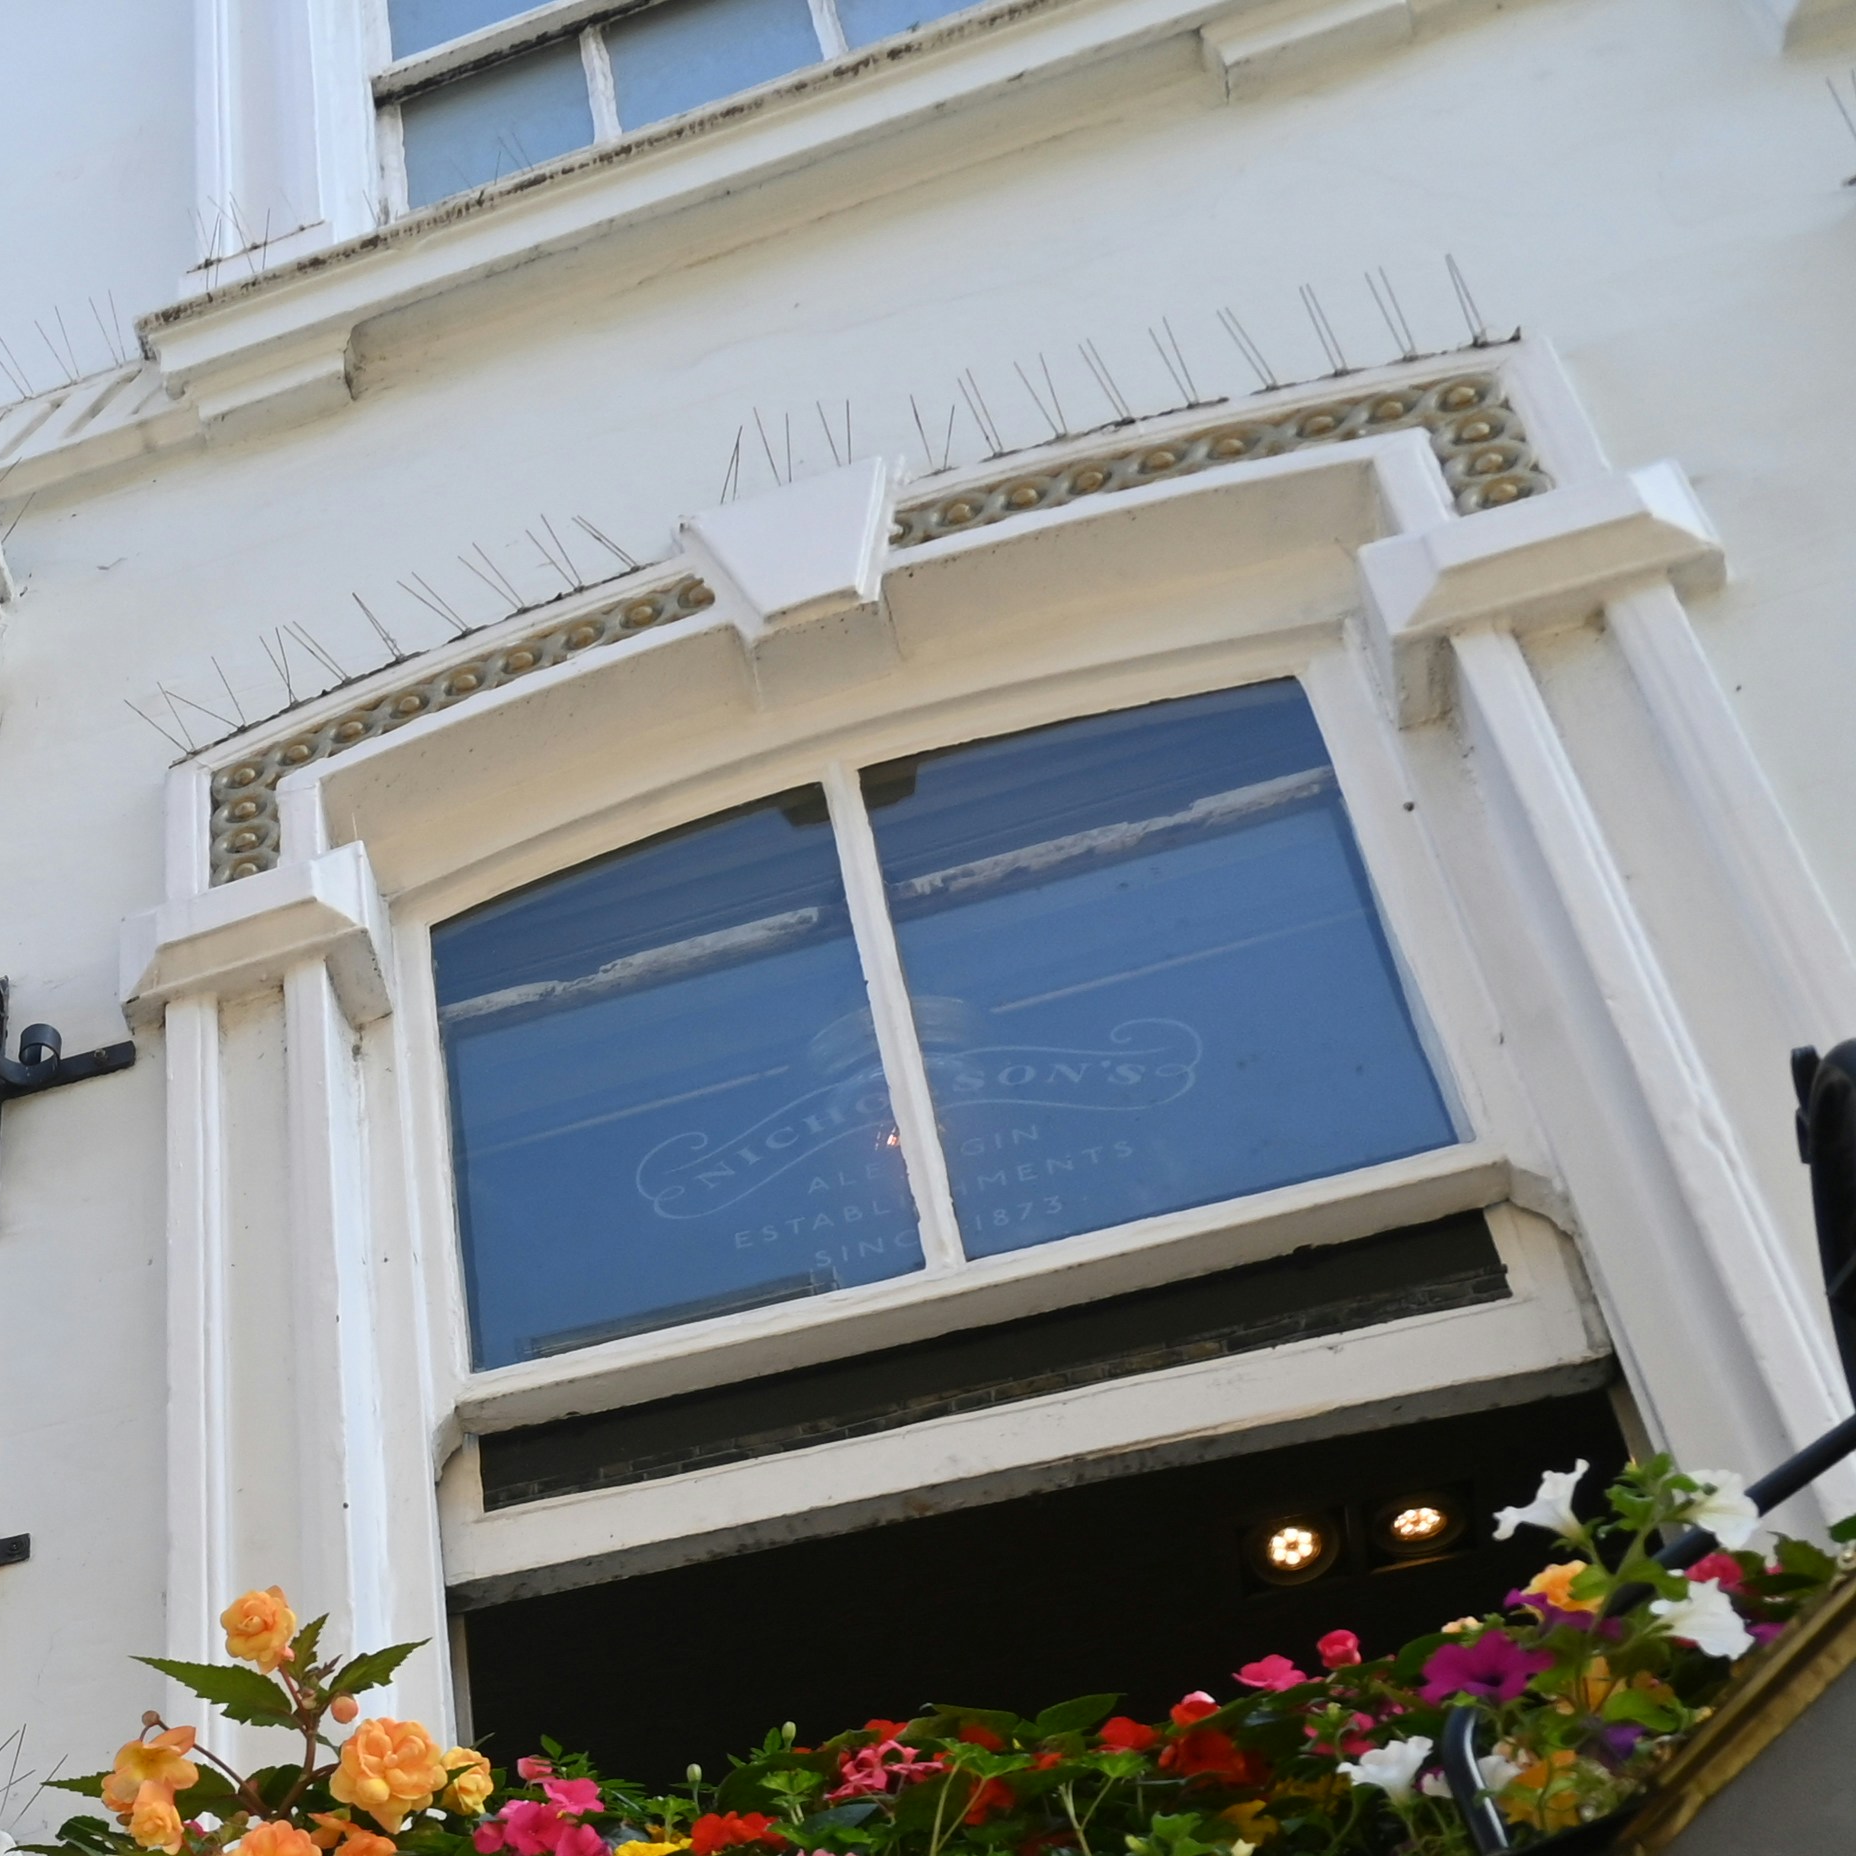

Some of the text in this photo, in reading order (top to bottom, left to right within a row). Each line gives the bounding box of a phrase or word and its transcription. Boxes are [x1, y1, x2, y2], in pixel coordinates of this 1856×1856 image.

[697, 1060, 1146, 1190] NICHOSON'S
[961, 1123, 1040, 1160] GIN
[814, 1229, 922, 1267] SINC
